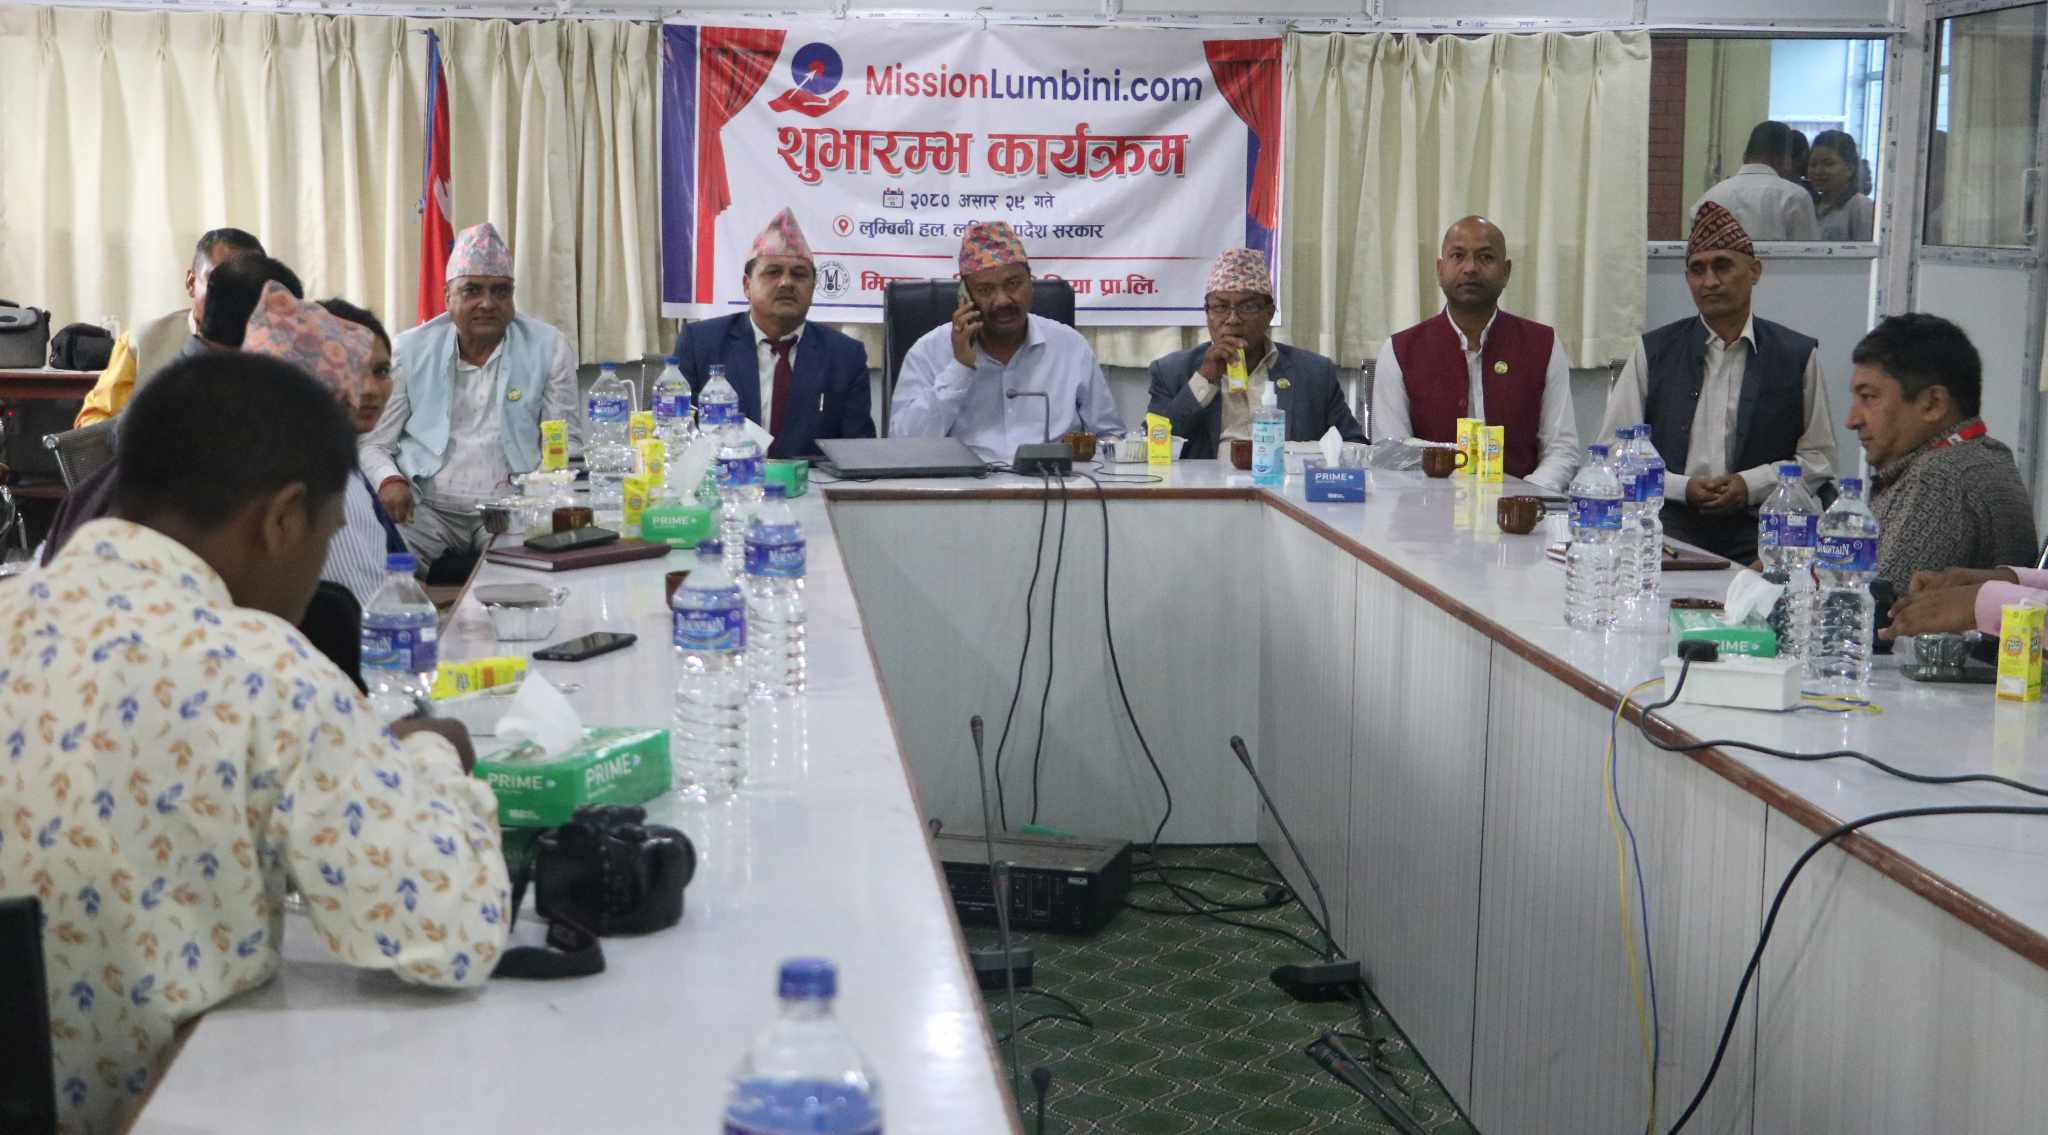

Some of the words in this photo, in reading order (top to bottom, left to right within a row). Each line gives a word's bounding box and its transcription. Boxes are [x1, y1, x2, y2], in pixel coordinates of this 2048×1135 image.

[866, 63, 1202, 102] MissionLumbini.com
[776, 126, 974, 183] शुभारम्भ
[987, 122, 1190, 178] कार्यक्रम
[910, 193, 950, 209] २०८०
[959, 193, 999, 209] असार
[1034, 192, 1055, 208] गते
[859, 217, 914, 237] लुम्बिनी
[1052, 223, 1105, 239] सरकार
[1315, 472, 1348, 481] PRIME
[1714, 640, 1750, 653] IME
[585, 752, 633, 788] PRIME
[487, 772, 544, 790] PRIME
